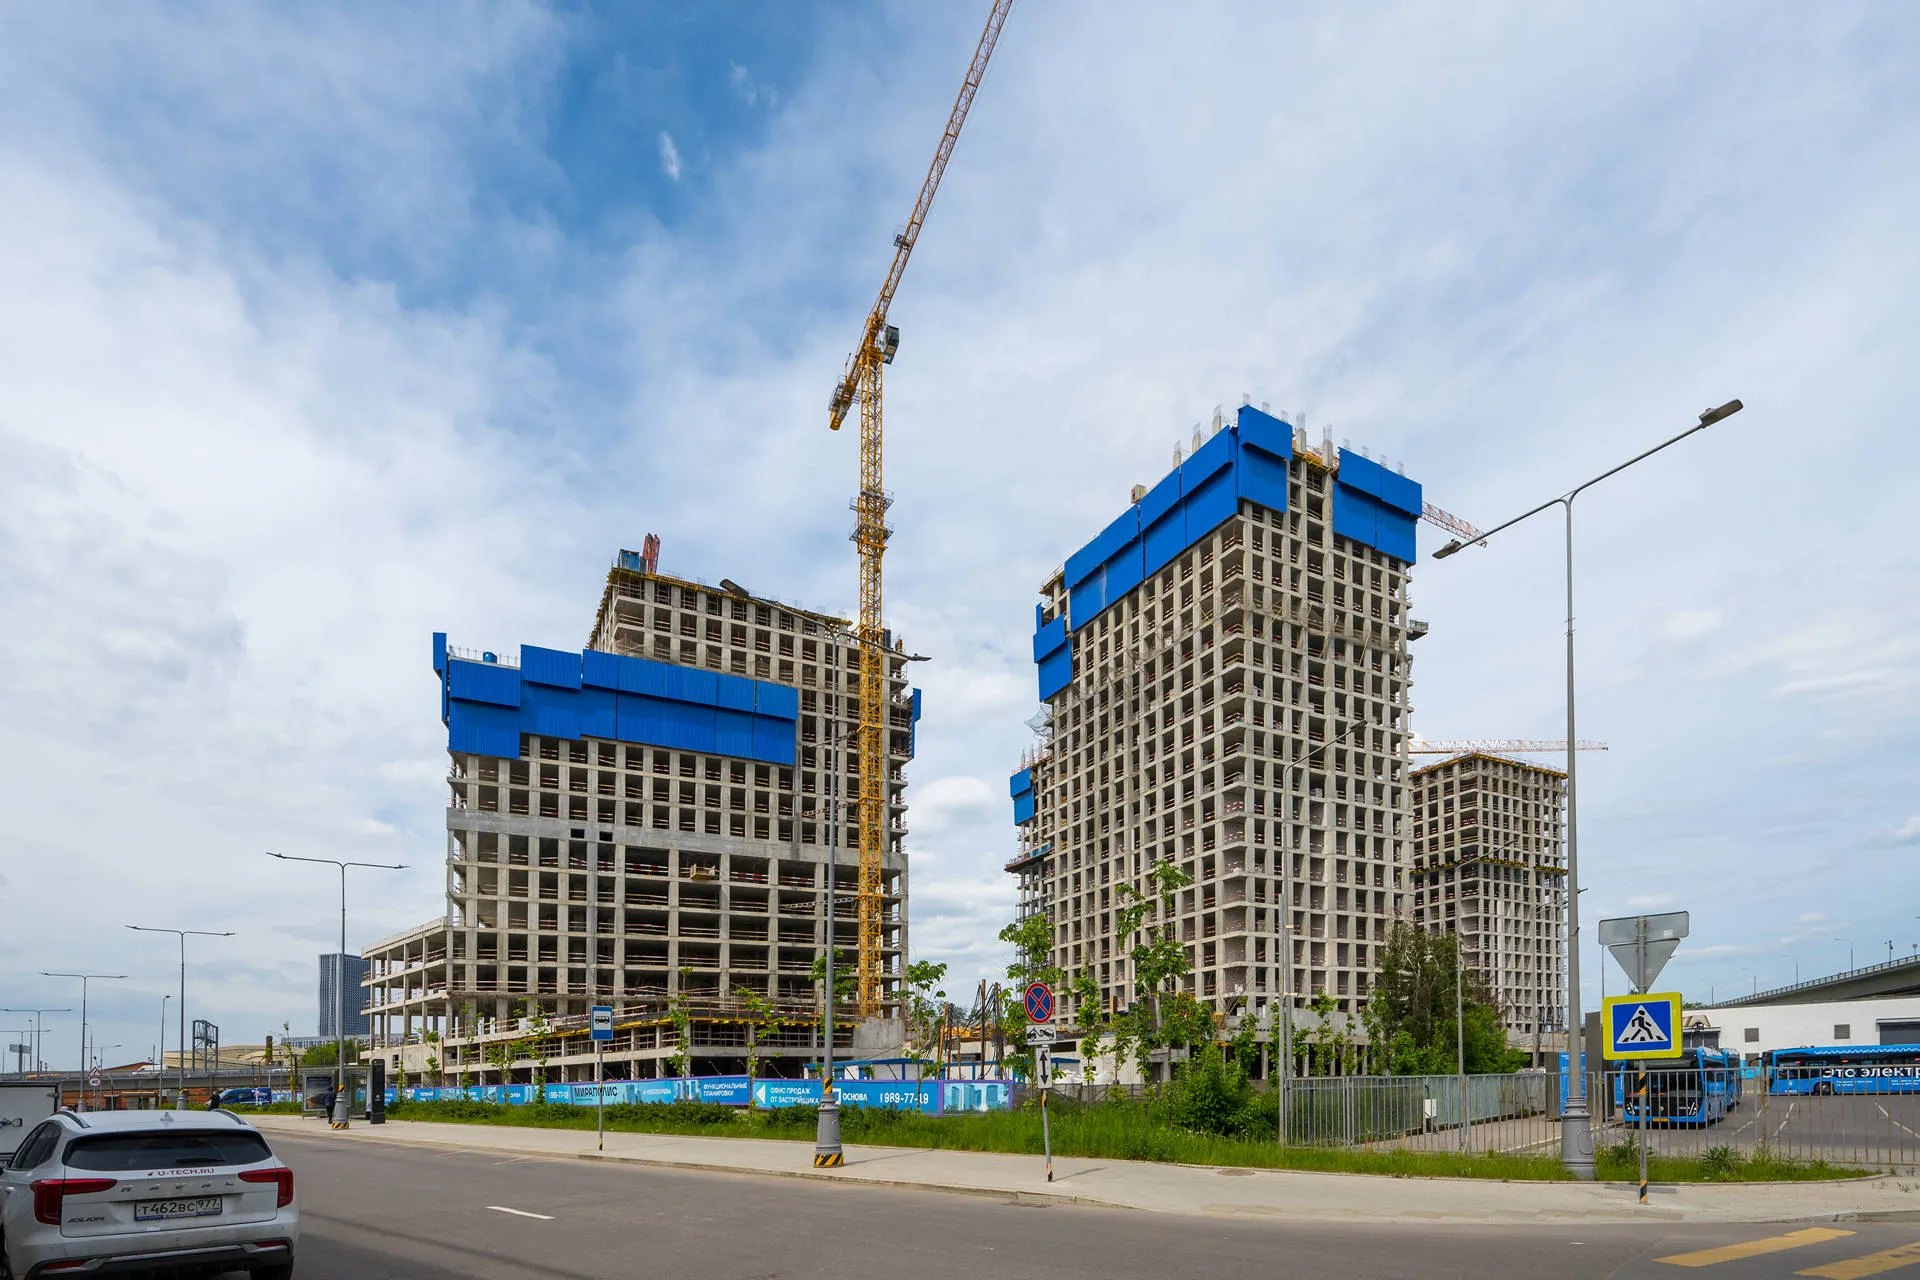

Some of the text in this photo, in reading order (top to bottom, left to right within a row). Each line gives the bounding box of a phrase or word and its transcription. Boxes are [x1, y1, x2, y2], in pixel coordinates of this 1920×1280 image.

[787, 1087, 811, 1095] ПРОДАЖ
[157, 1168, 215, 1176] U-TECH.RU
[197, 1198, 218, 1208] 977
